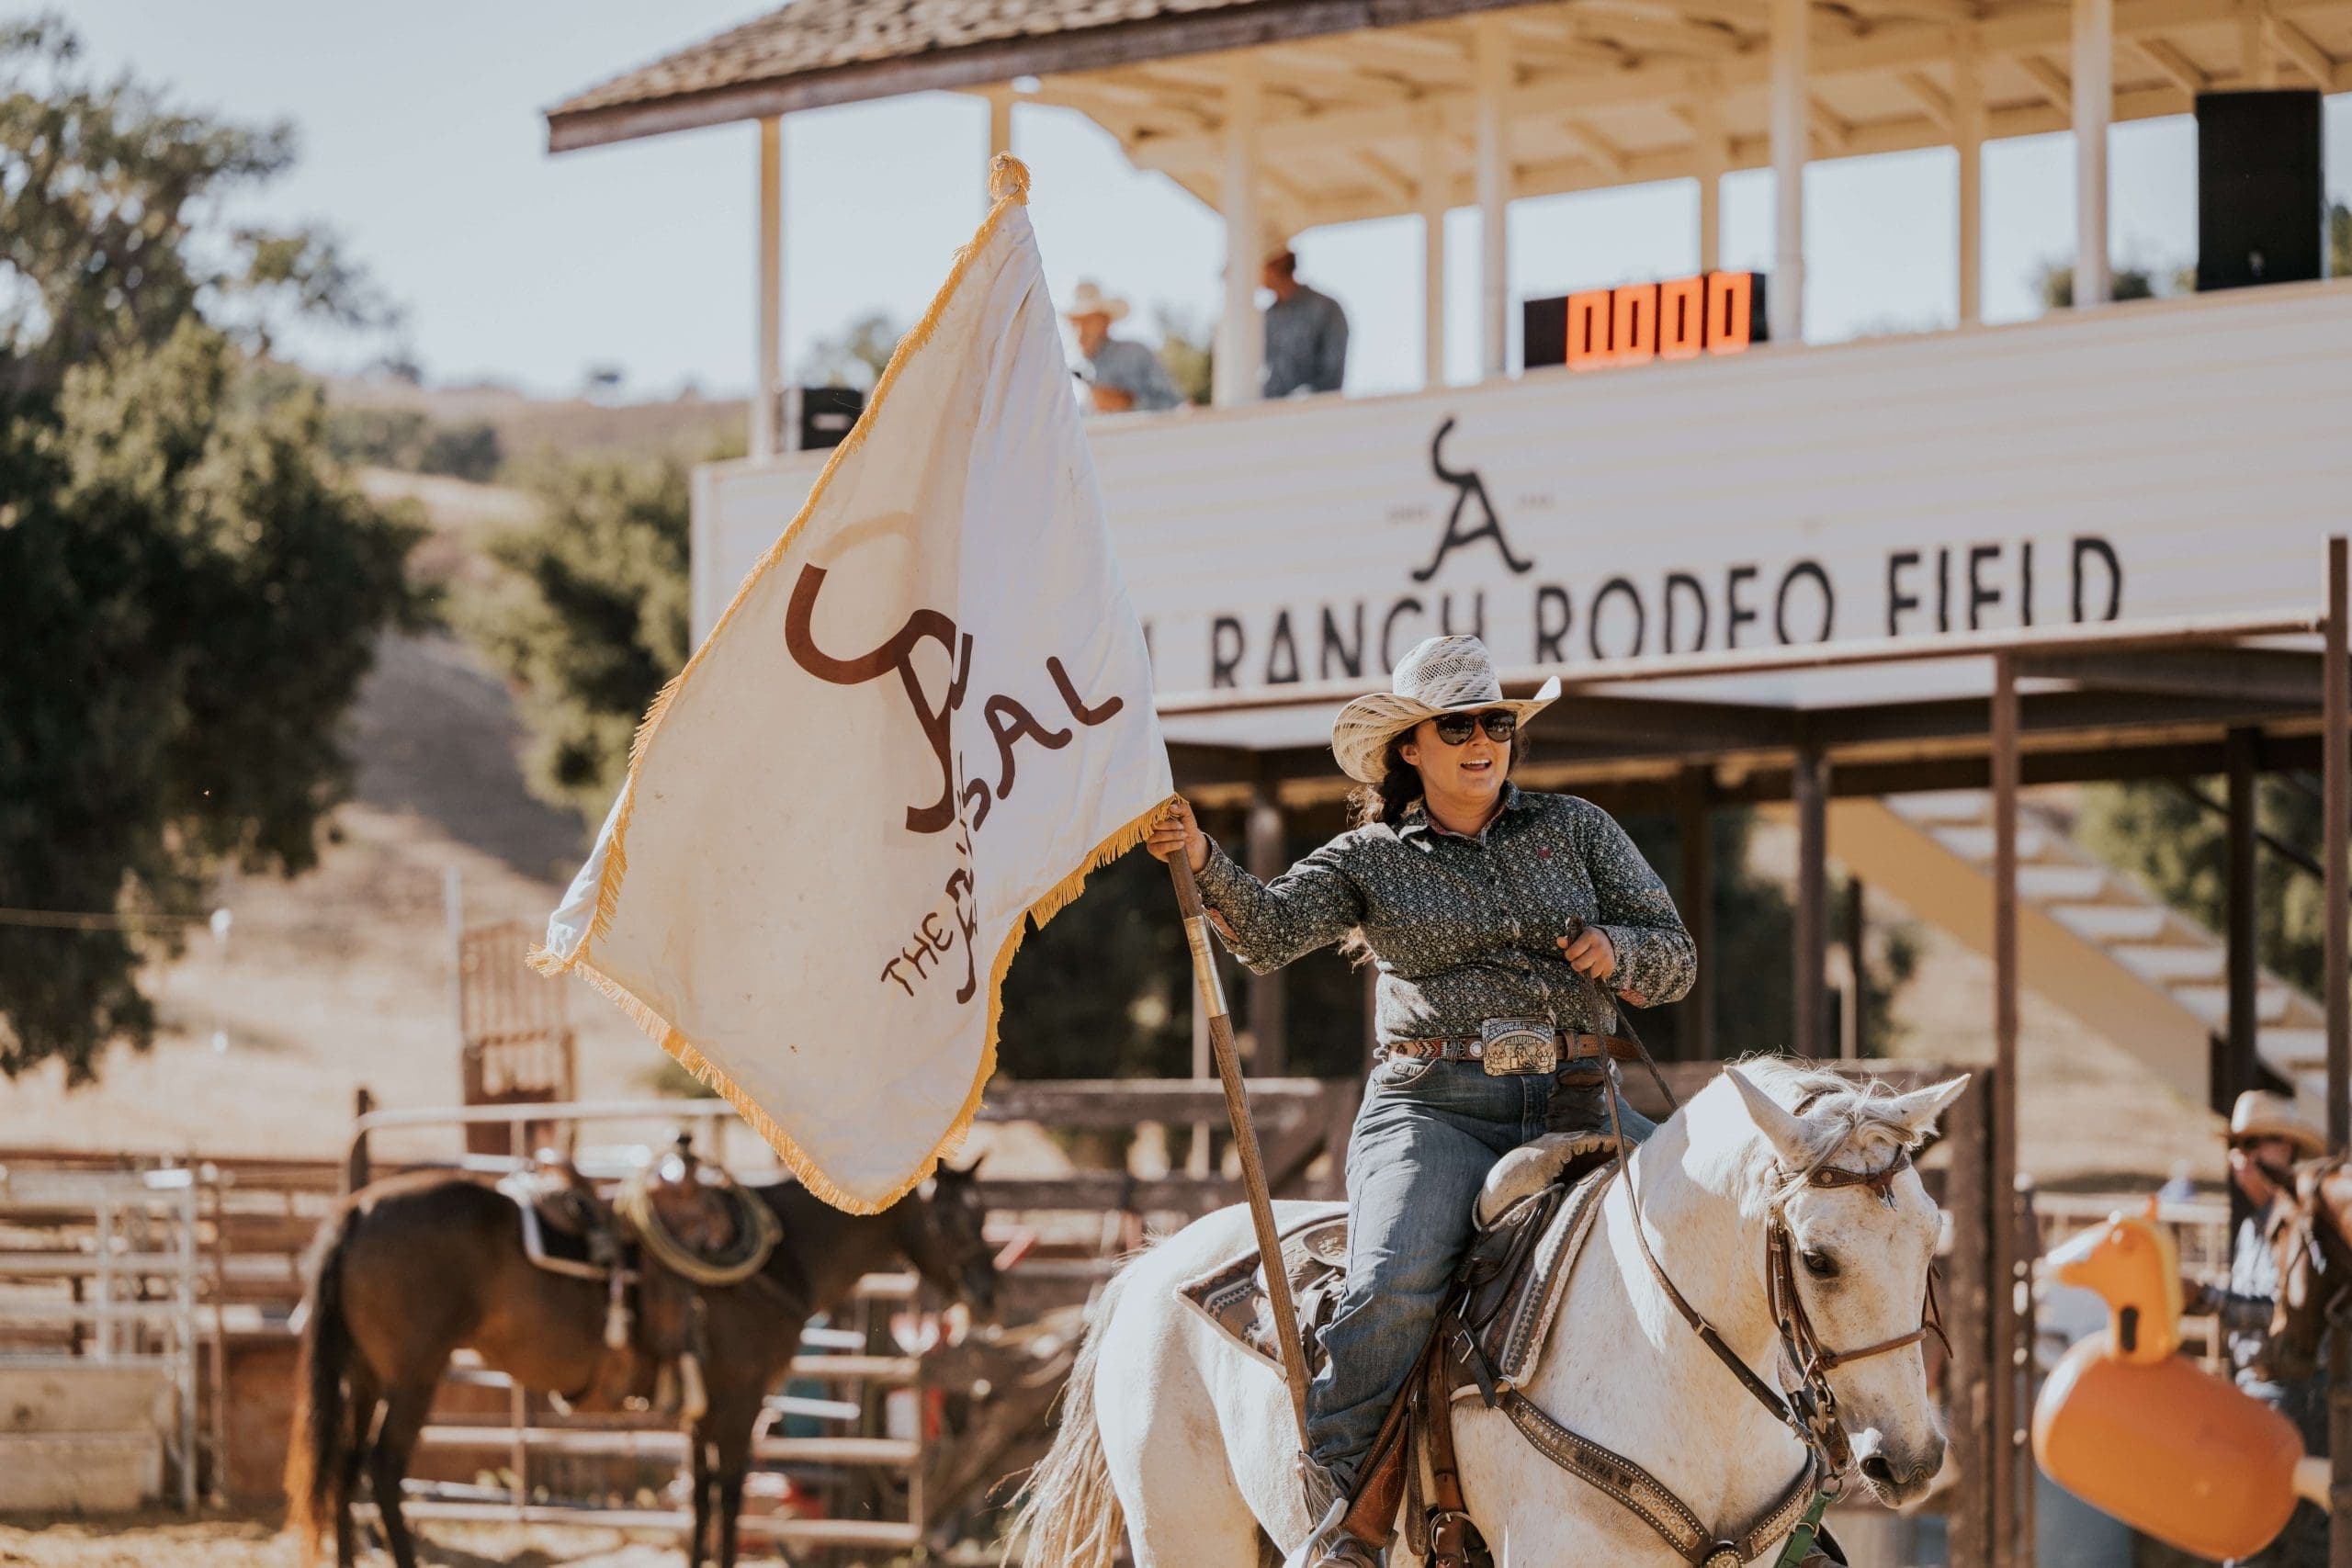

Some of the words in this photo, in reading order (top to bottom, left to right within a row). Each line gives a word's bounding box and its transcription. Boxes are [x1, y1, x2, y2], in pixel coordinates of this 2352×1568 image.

[1535, 560, 1834, 664] RODEO
[1888, 536, 2121, 637] FIELD
[880, 911, 954, 997] THE
[1507, 1035, 1536, 1045] CHAMPION
